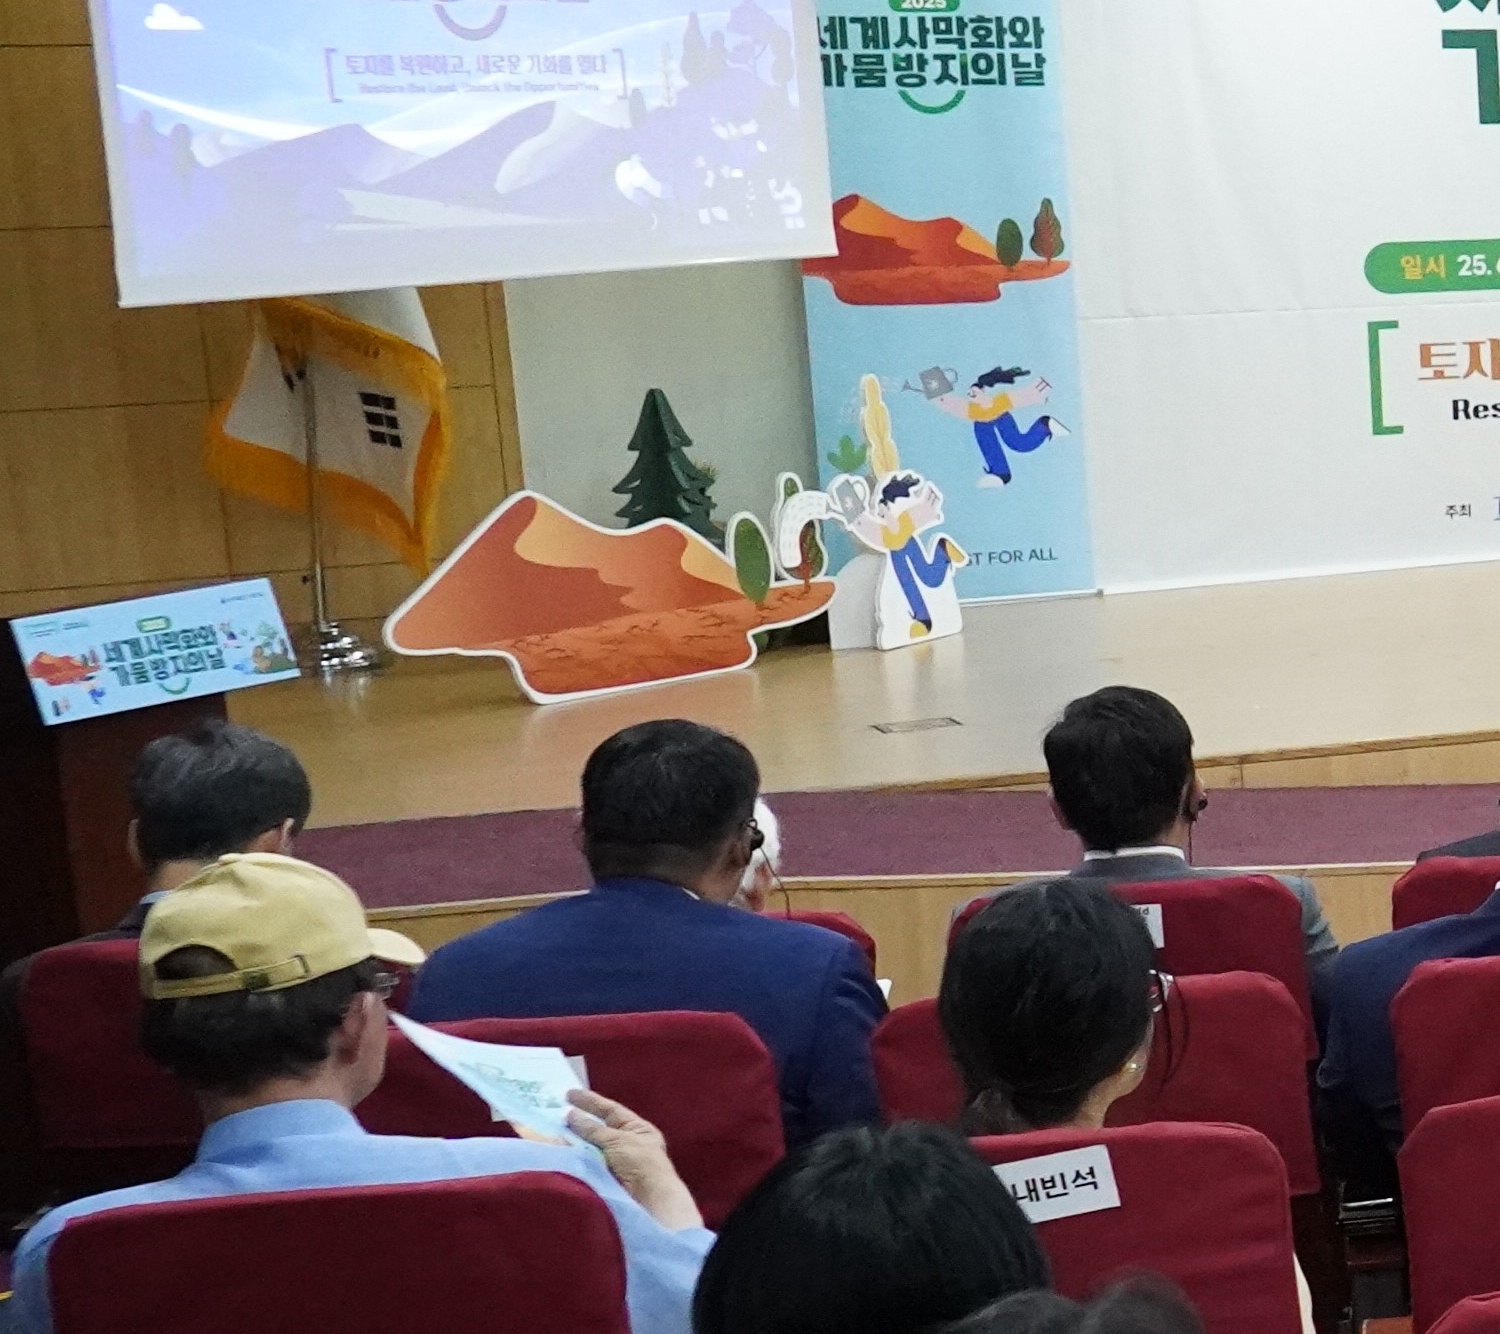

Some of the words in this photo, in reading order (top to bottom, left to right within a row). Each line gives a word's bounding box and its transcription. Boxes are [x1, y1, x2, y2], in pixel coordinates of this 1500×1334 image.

[1400, 254, 1446, 281] 일시
[1444, 503, 1472, 519] 주최
[988, 549, 1023, 566] FOR
[1028, 547, 1058, 563] ALL
[1010, 1165, 1100, 1204] 내빈석
